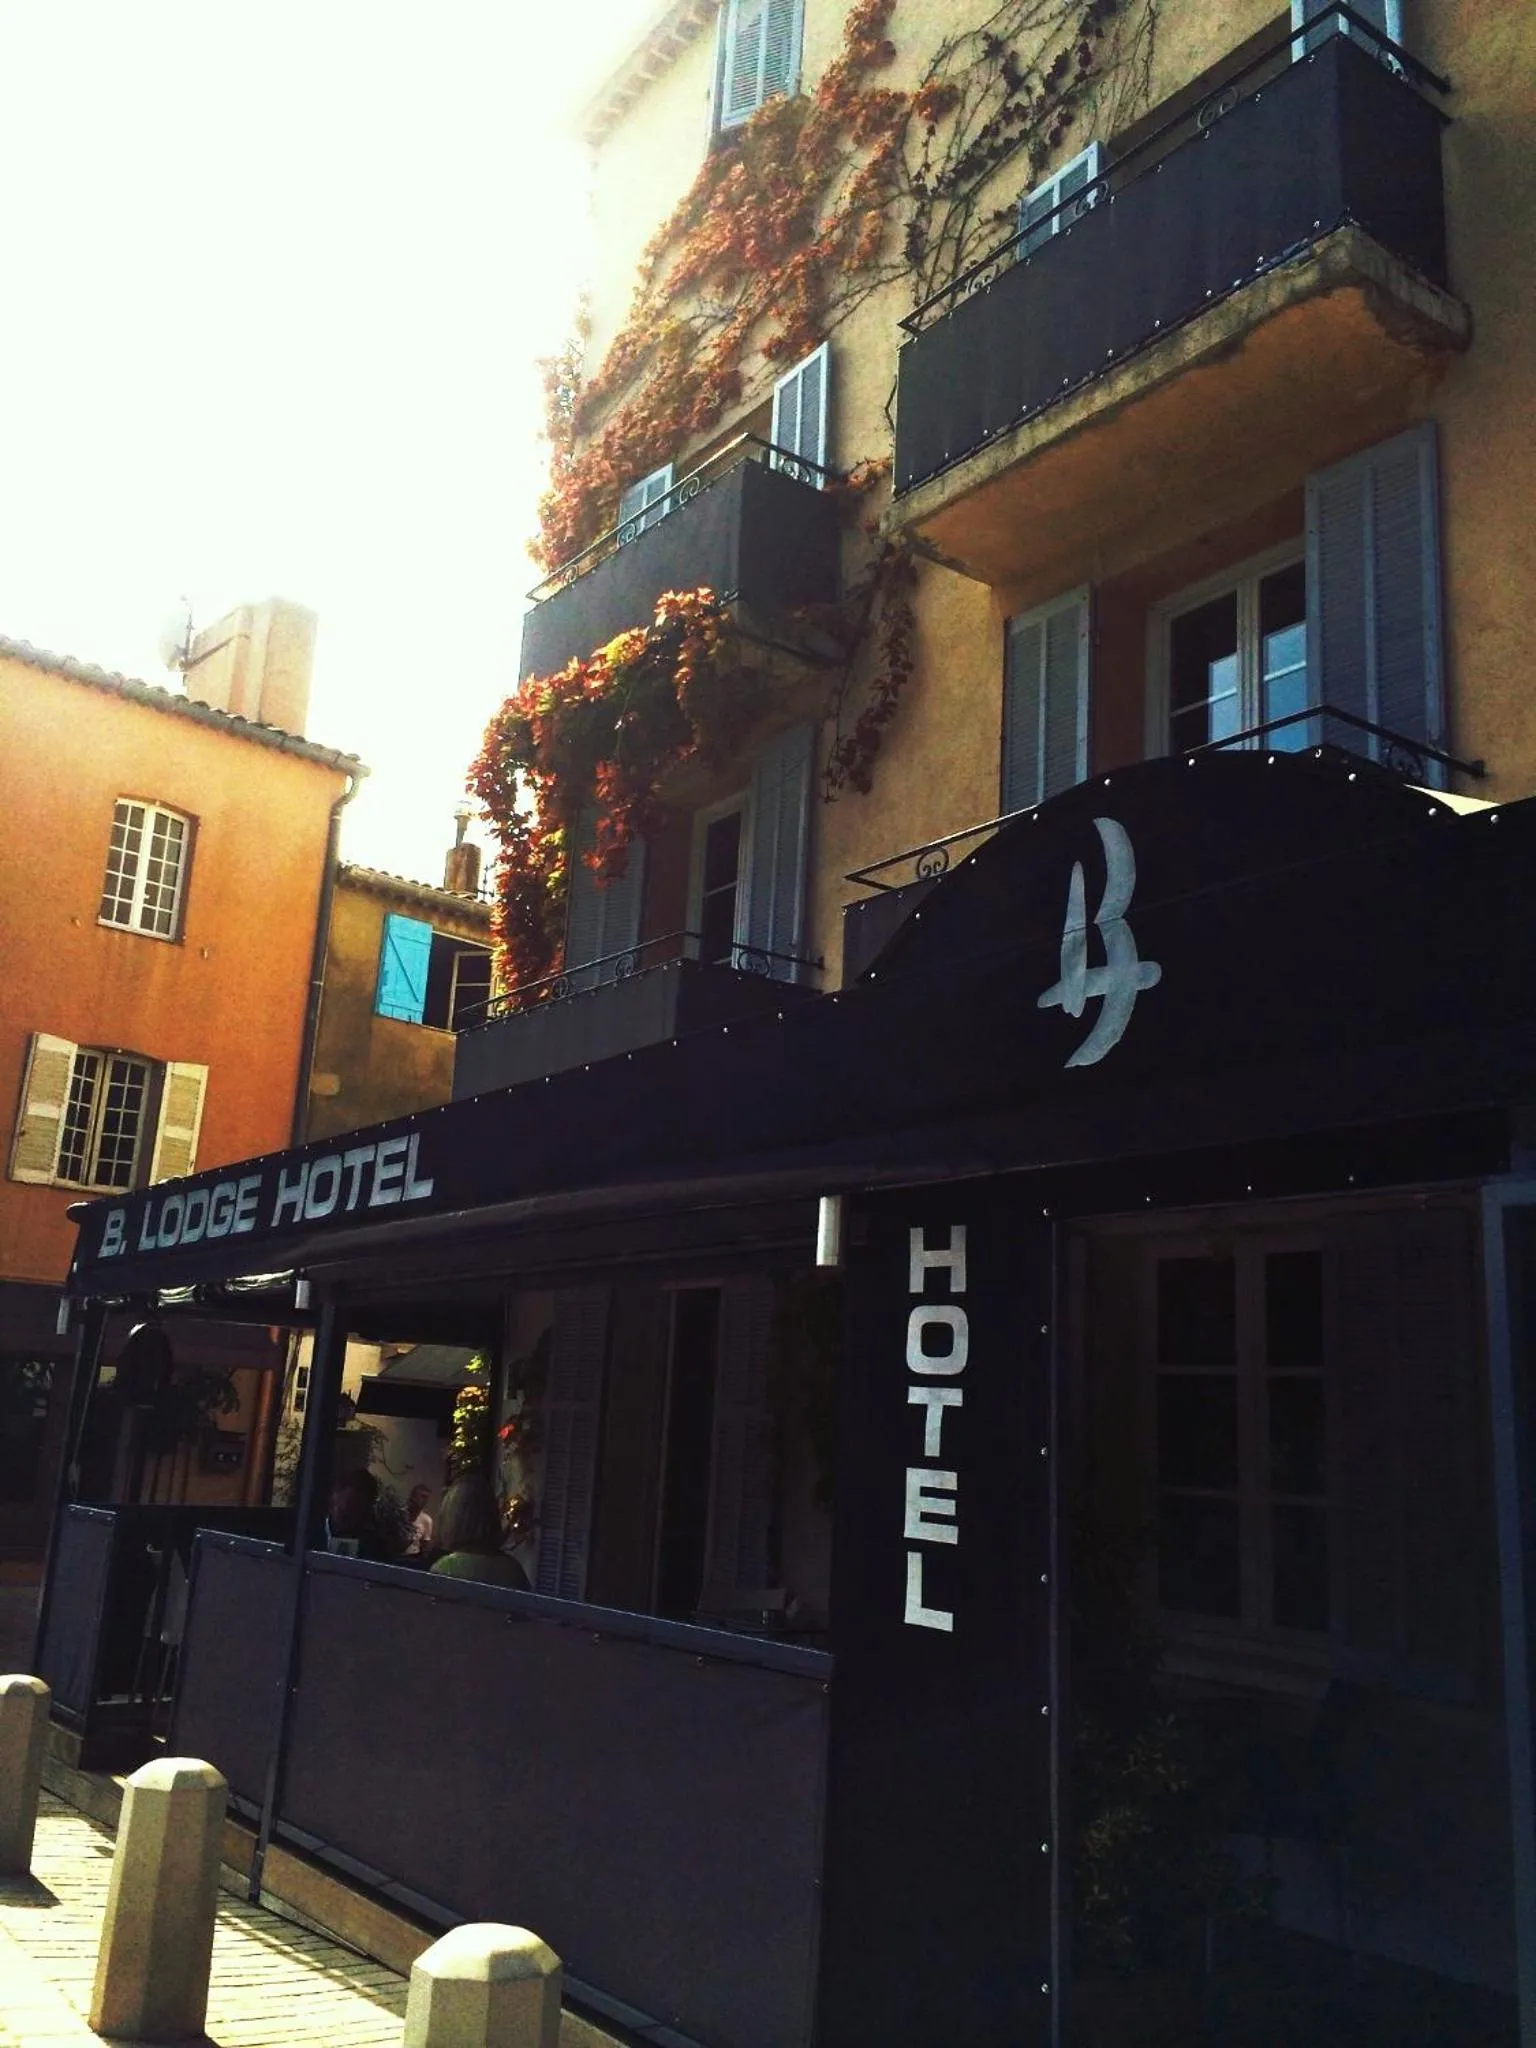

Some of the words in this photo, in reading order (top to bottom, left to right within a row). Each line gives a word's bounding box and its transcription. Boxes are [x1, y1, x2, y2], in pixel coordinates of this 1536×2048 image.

[138, 1175, 262, 1252] LODGE
[271, 1133, 434, 1227] HOTEL
[904, 1224, 968, 1632] HOTEL
